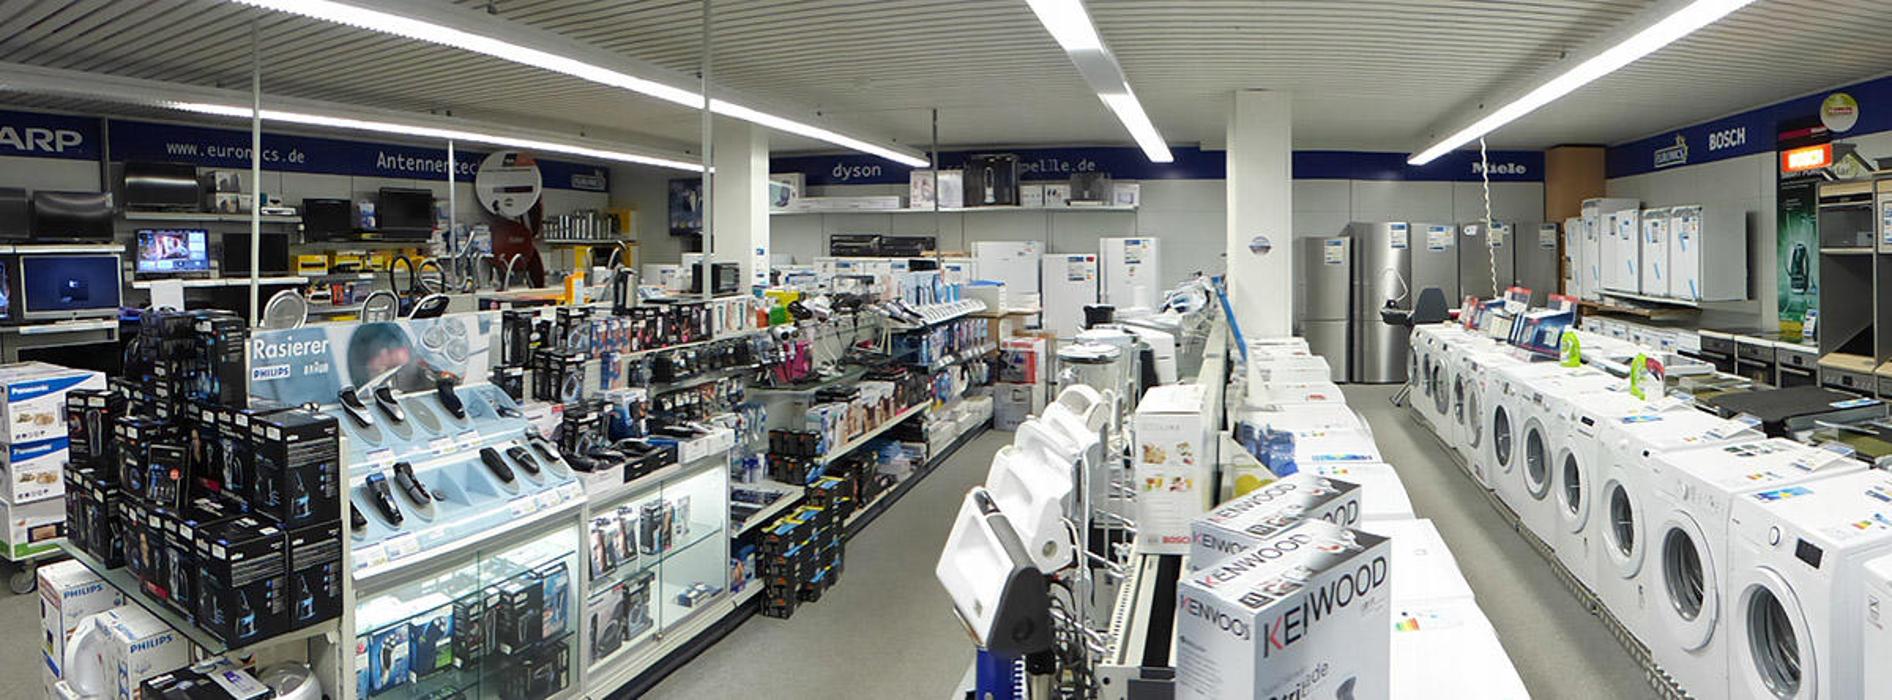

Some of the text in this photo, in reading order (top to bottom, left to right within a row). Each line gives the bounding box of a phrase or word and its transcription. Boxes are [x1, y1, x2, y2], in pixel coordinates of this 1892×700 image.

[1708, 127, 1746, 151] BOSCH
[166, 142, 305, 163] www.euroncs.de
[832, 162, 881, 181] dyson
[253, 335, 328, 359] Rasierer
[253, 366, 289, 379] PHILIPS
[1207, 483, 1297, 524] KENWOOD
[1162, 535, 1192, 545] BOSC
[1195, 533, 1312, 589] KENWOOD
[63, 582, 104, 599] PHILIPS
[130, 634, 174, 654] PHILIPS
